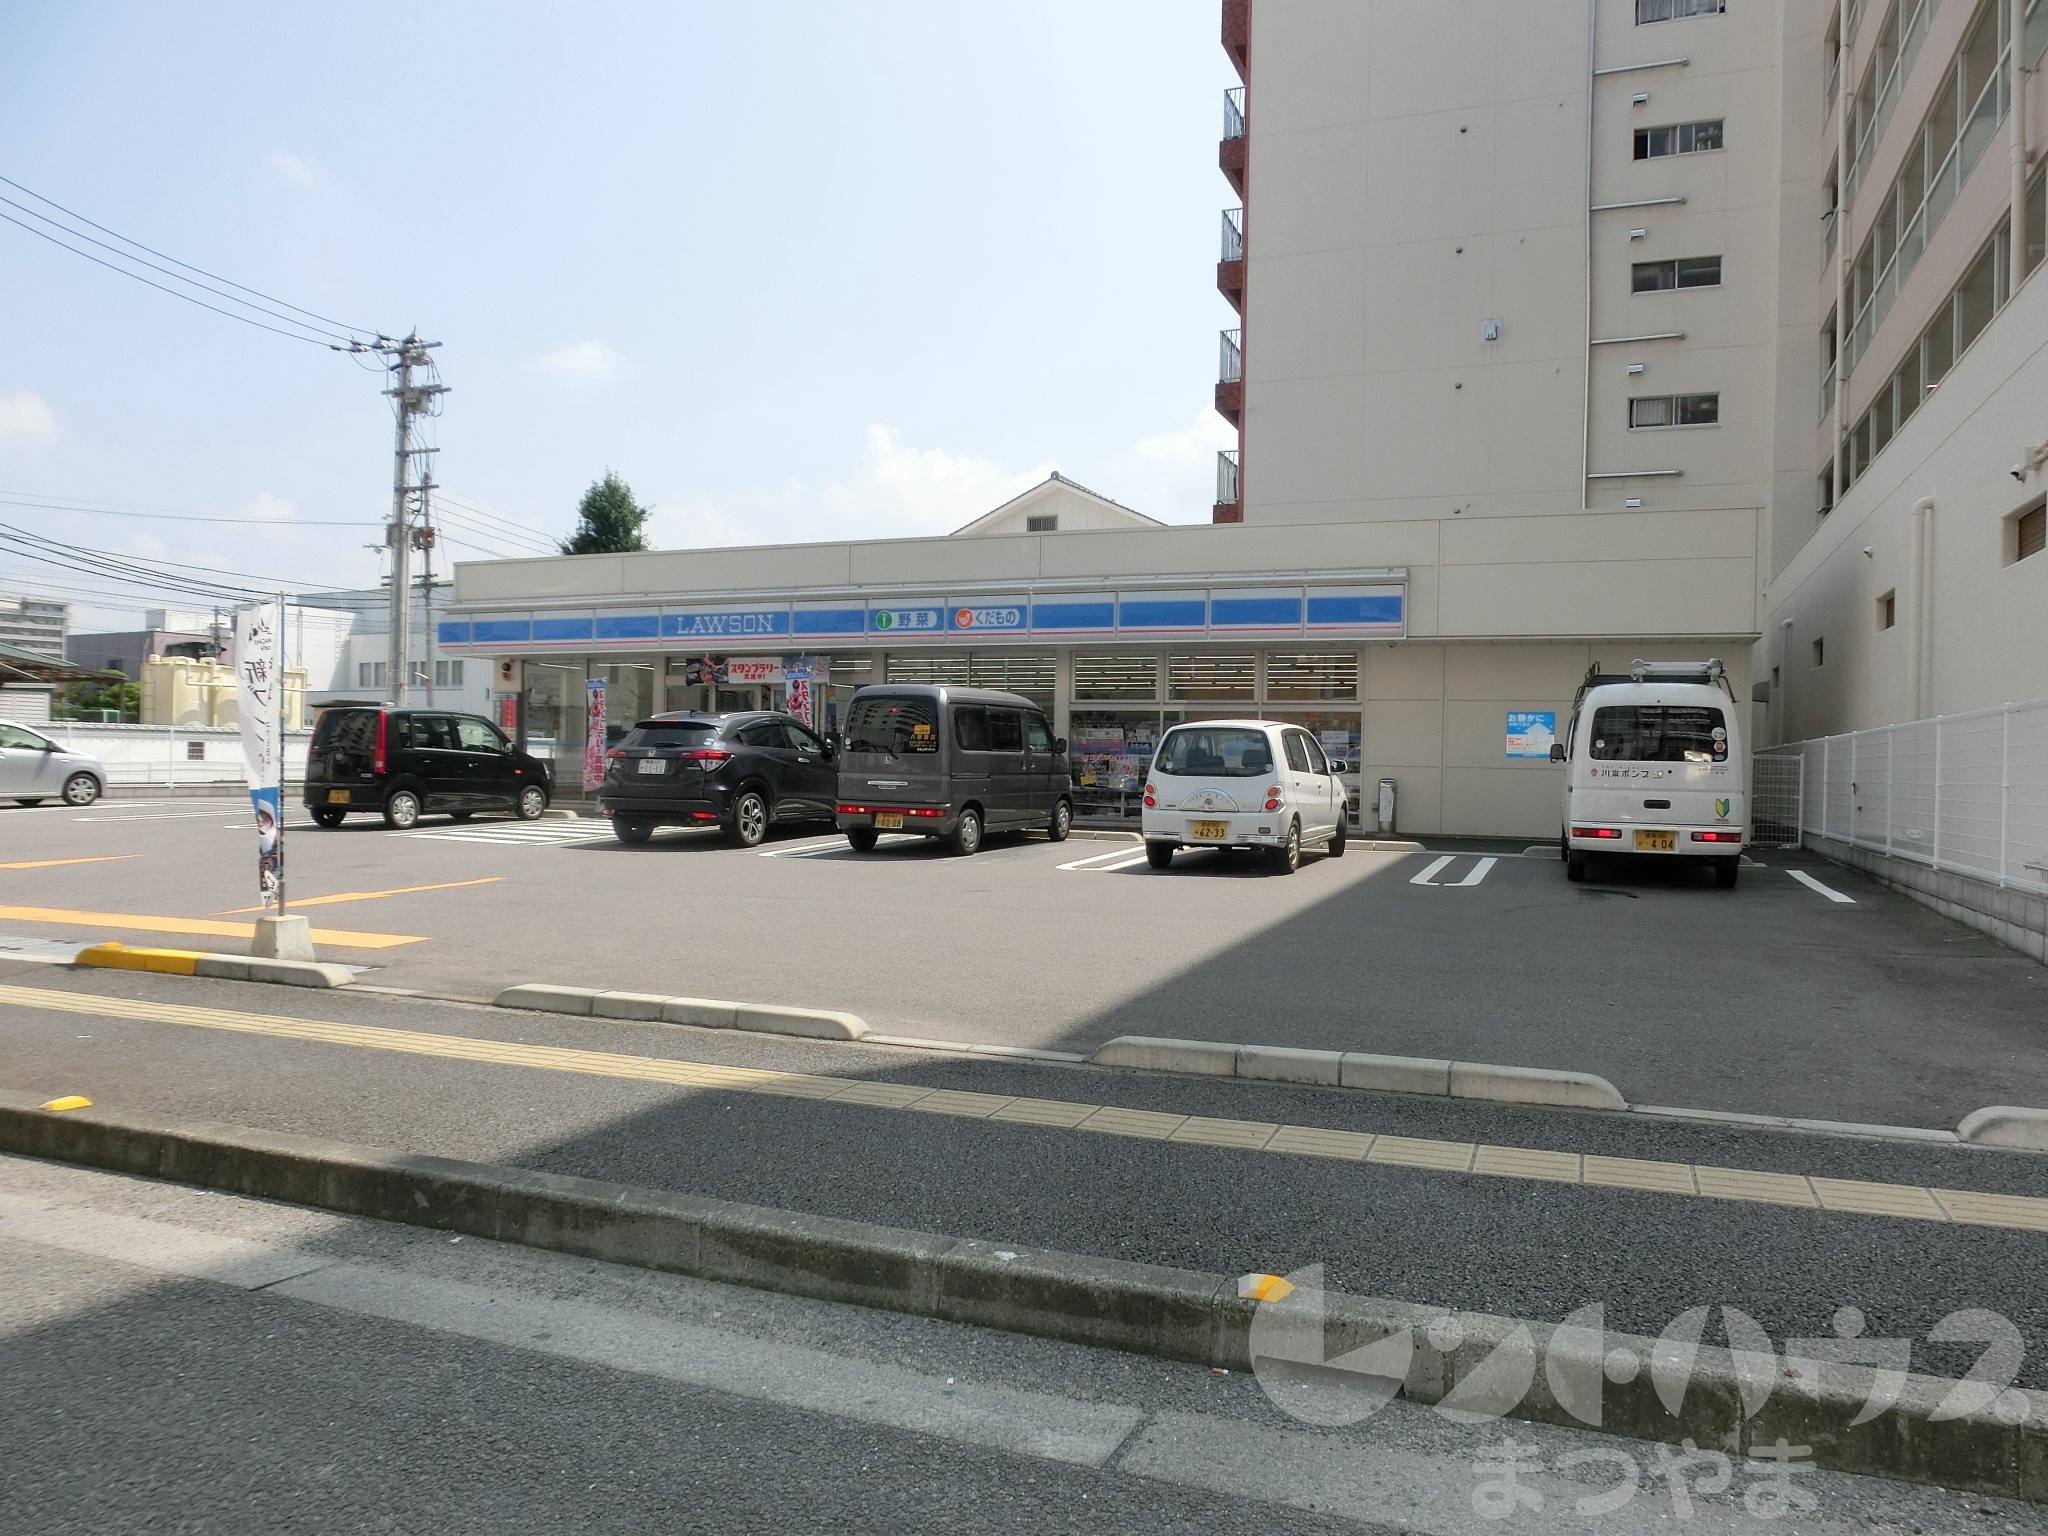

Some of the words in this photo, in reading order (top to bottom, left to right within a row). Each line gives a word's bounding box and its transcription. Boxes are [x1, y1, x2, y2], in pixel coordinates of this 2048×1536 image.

[676, 614, 774, 634] LAWSON
[897, 611, 929, 627] 野菜
[975, 612, 1016, 626] くだもの
[730, 663, 780, 674] スタンプラリー
[1199, 828, 1225, 838] 62-33
